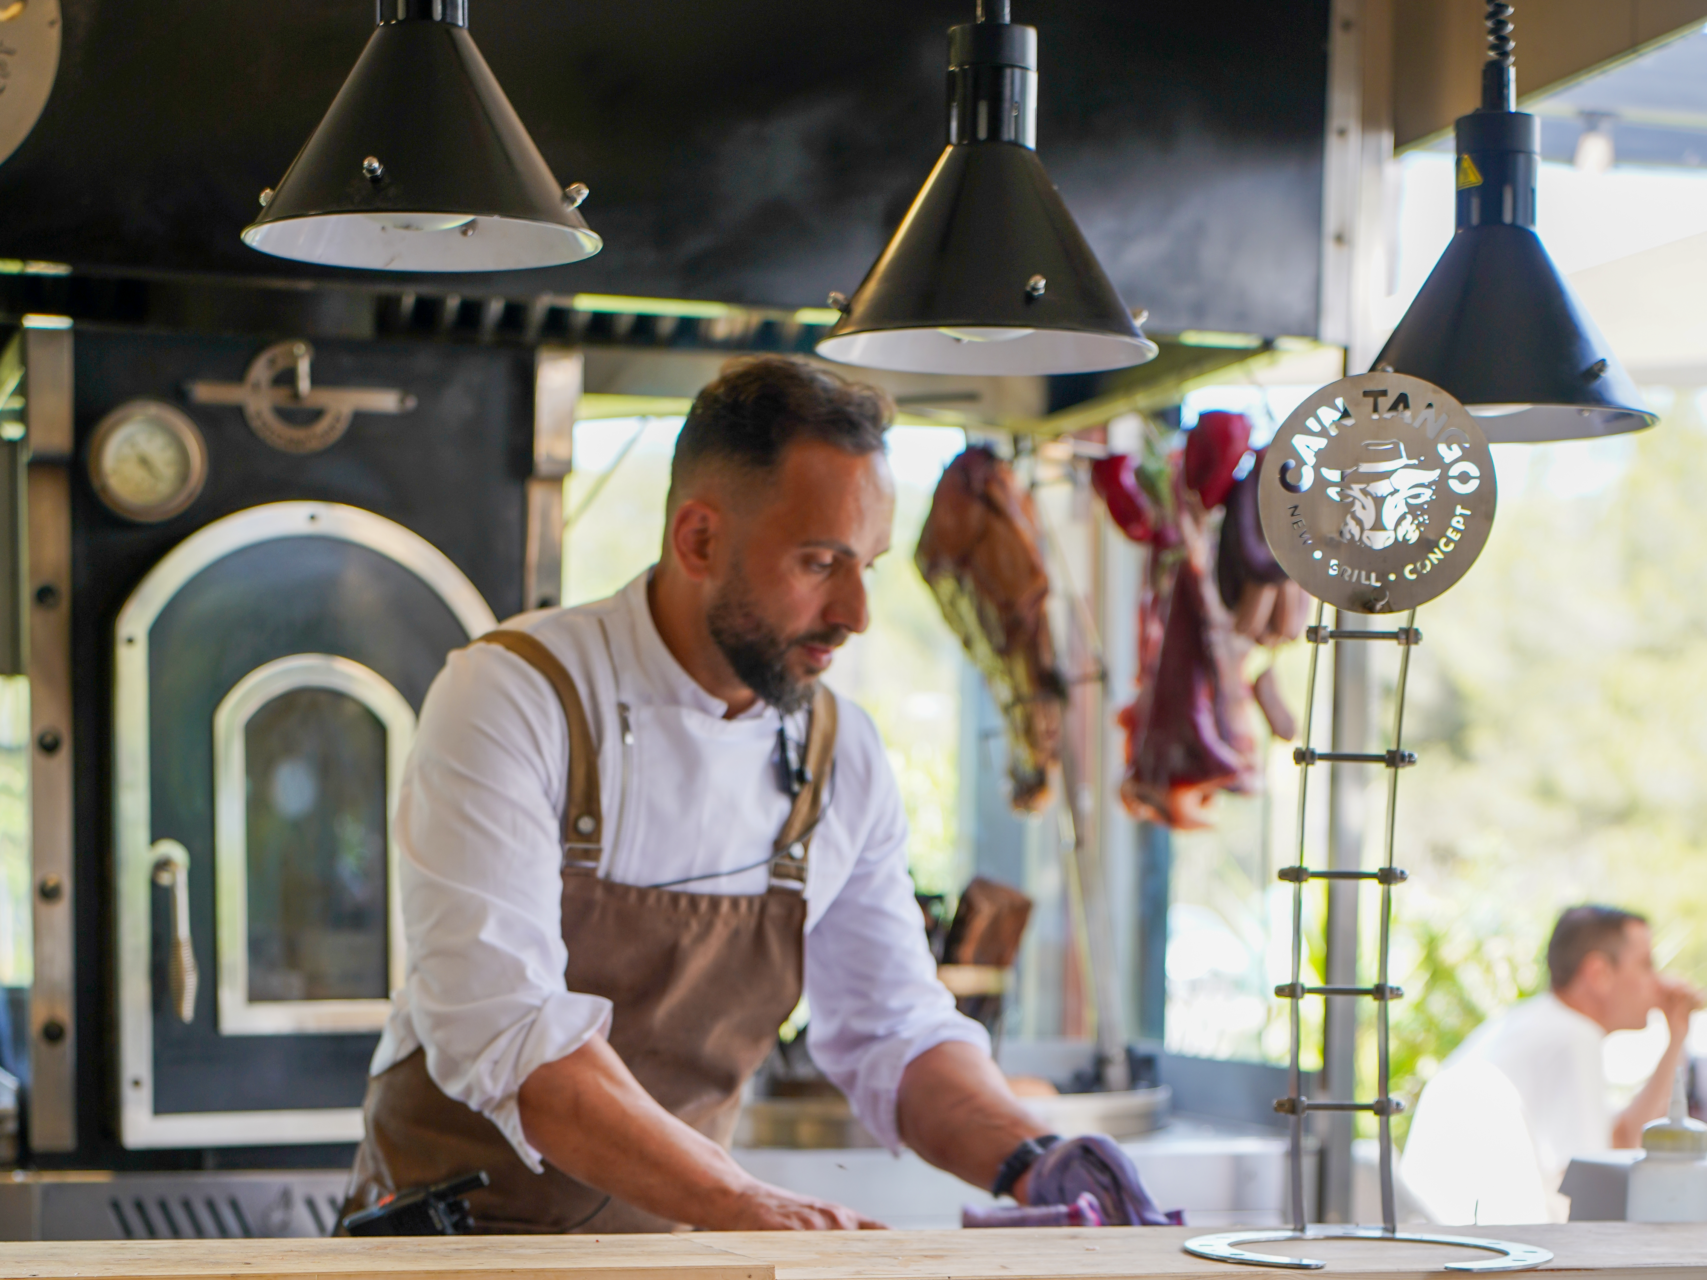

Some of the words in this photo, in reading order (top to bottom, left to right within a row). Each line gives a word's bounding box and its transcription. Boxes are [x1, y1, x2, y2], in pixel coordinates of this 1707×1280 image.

[1362, 389, 1481, 495] TANGO
[1287, 503, 1314, 546] NEW
[1328, 559, 1382, 587] GRILL
[1403, 504, 1472, 581] CONCEPT
